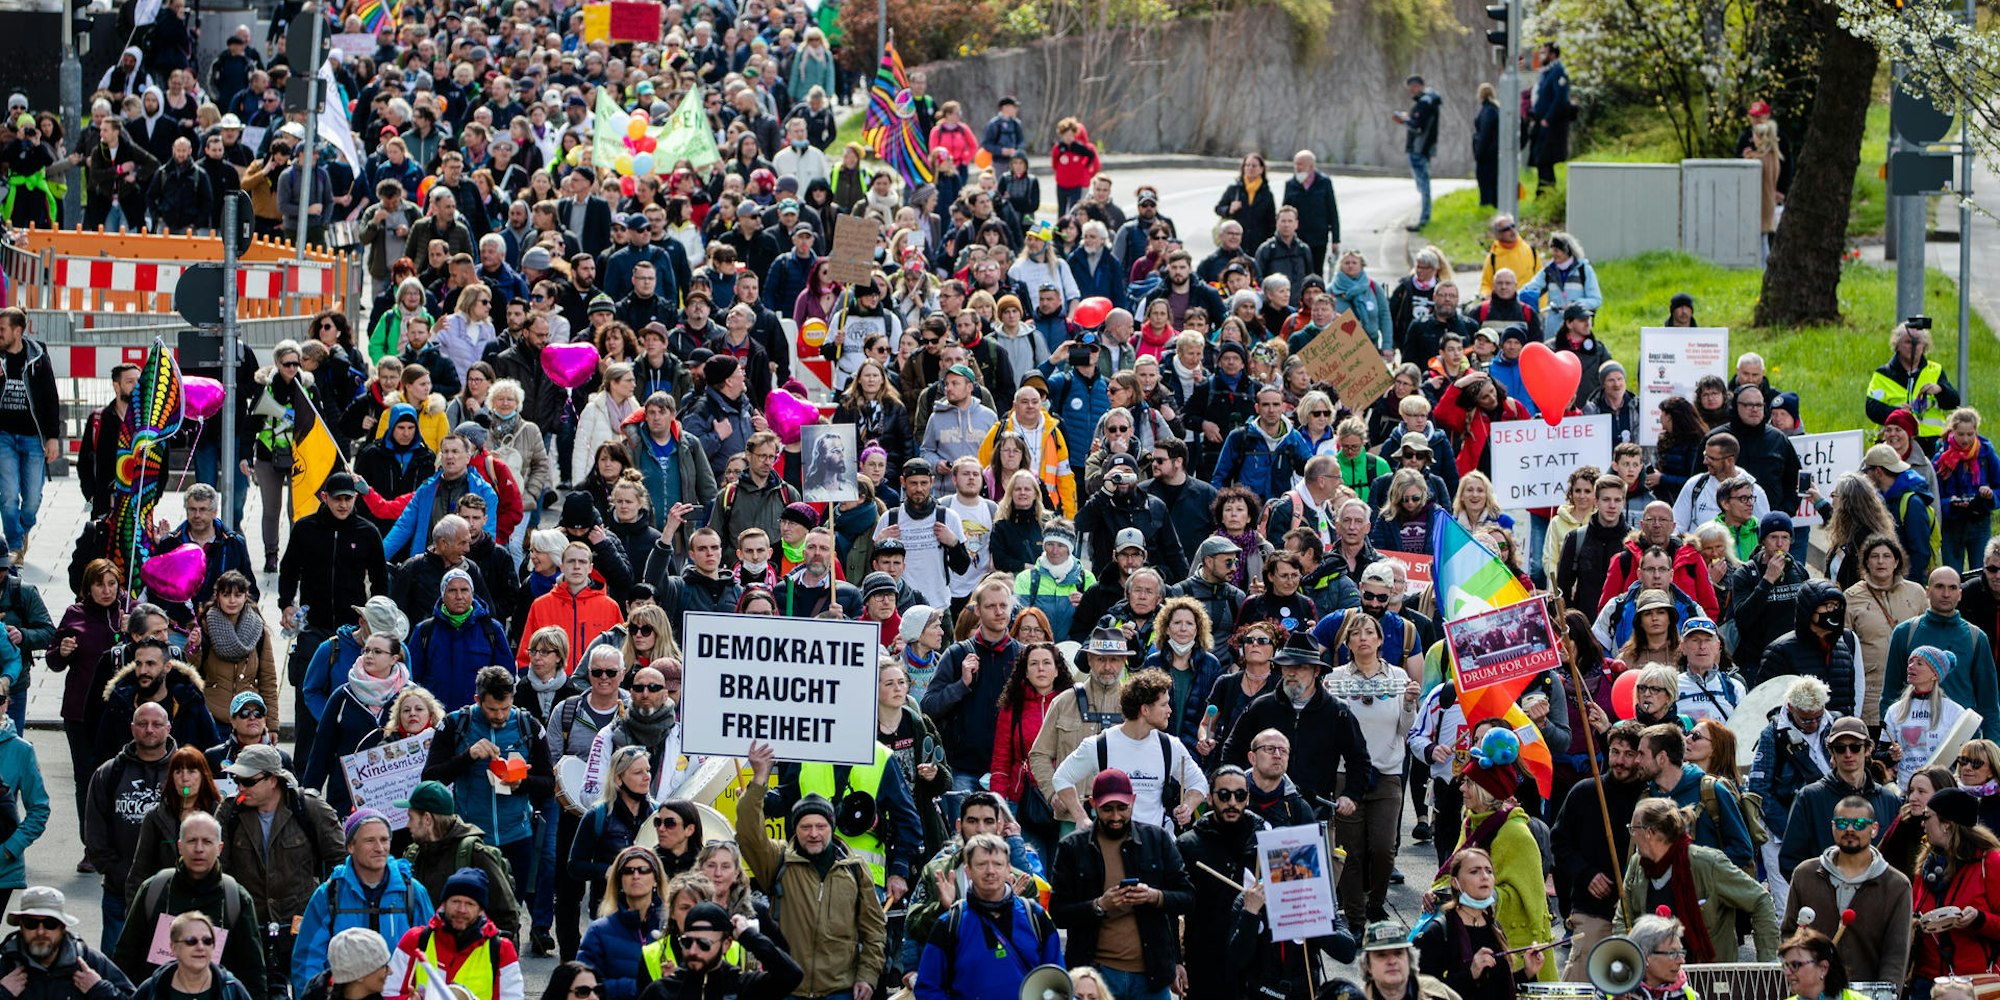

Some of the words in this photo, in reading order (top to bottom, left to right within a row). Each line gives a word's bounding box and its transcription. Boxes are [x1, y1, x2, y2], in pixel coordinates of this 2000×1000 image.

[1494, 428, 1537, 444] JESU
[1547, 424, 1594, 440] LIEBE
[1520, 452, 1580, 470] STATT
[1511, 482, 1566, 499] DIKTA
[698, 633, 865, 667] DEMOKRATIE
[1462, 666, 1500, 684] DRUM
[1500, 658, 1523, 674] FOR
[1525, 650, 1555, 667] LOVE
[720, 673, 840, 704] BRAUCHT
[722, 713, 836, 743] FREIHEIT
[355, 748, 427, 781] Kindesmissh
